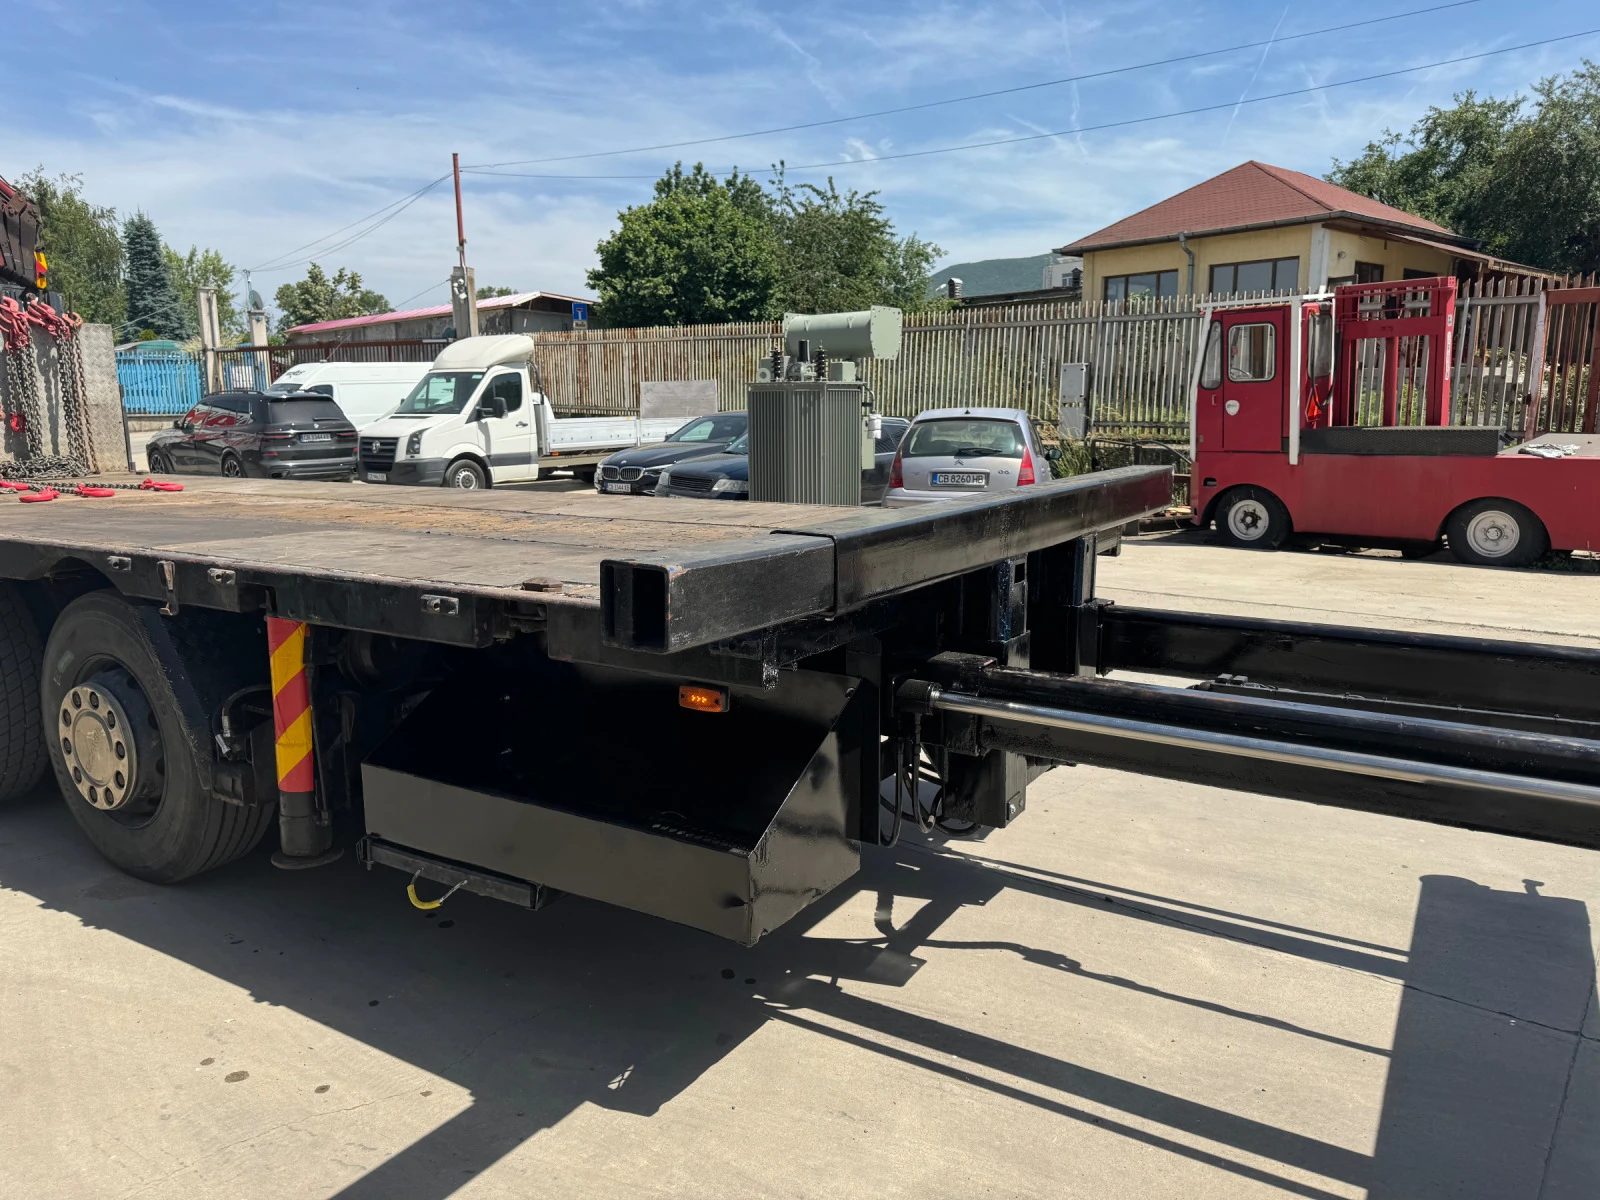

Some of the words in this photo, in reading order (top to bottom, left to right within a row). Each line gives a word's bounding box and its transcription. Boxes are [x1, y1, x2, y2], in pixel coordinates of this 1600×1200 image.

[938, 474, 949, 484] CB
[950, 474, 971, 484] 8260
[972, 475, 984, 484] HB
